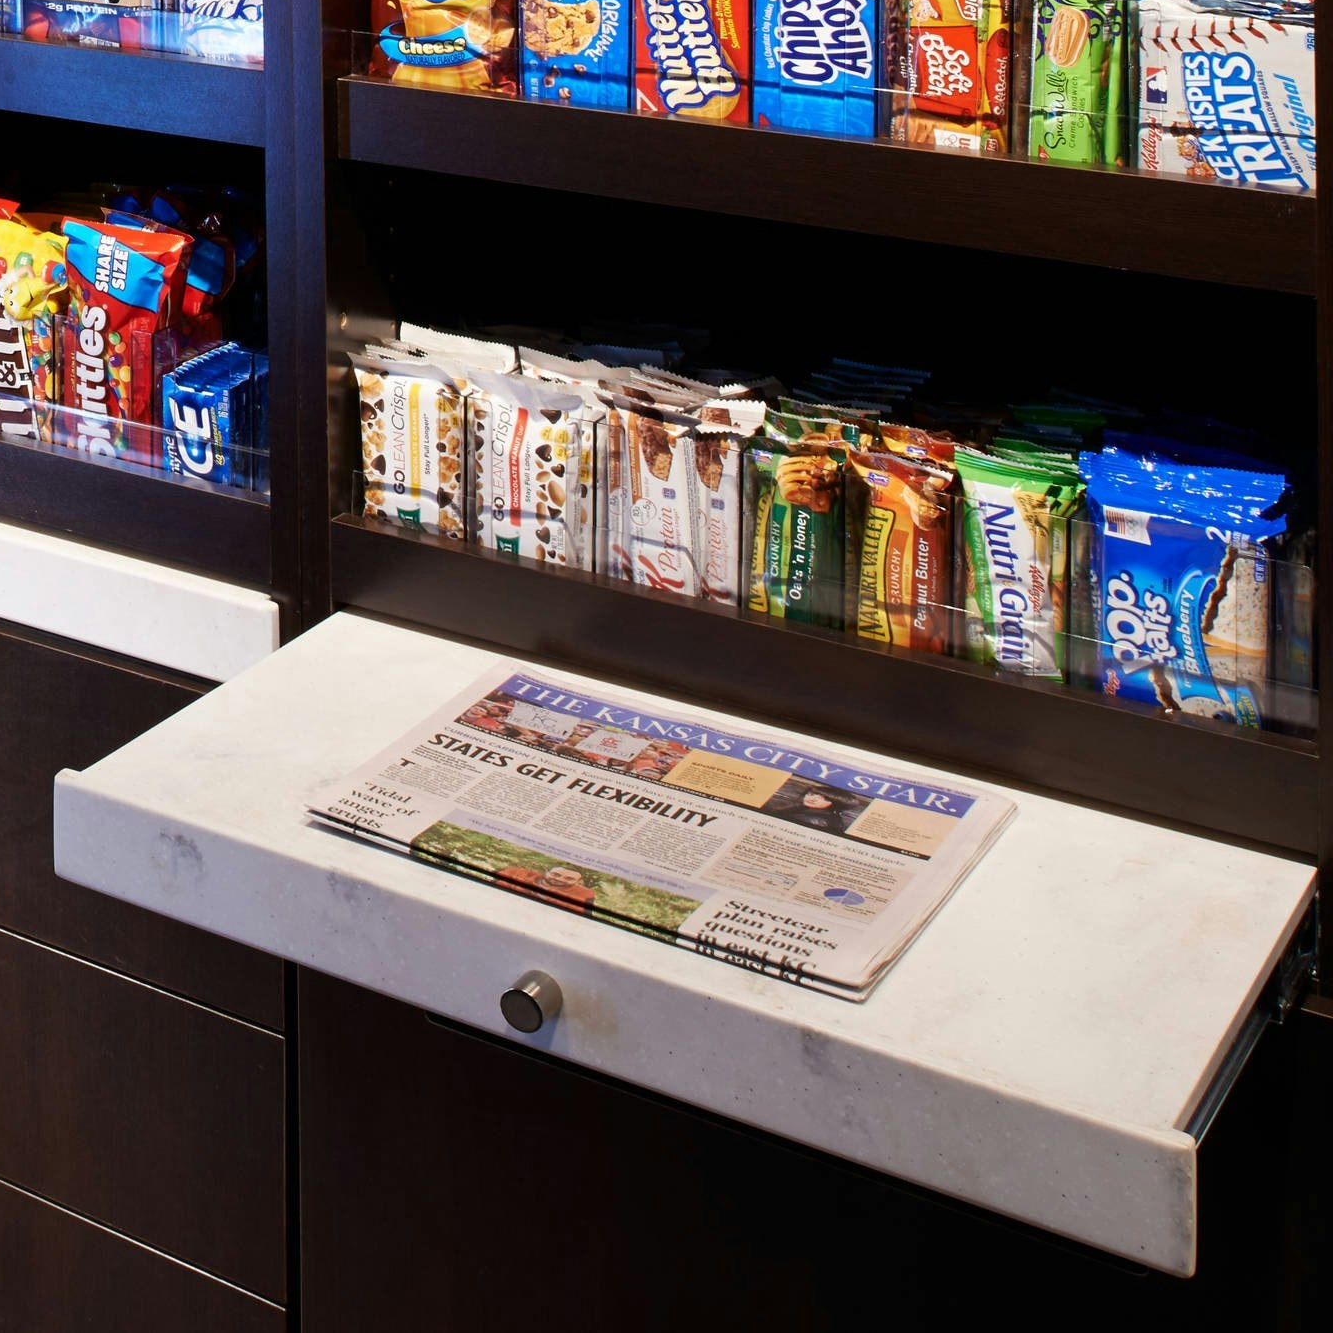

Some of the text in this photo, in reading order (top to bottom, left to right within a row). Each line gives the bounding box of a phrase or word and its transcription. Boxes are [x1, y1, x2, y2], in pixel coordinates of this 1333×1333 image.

[65, 3, 118, 16] PROTEIN
[398, 37, 466, 56] Cheese
[941, 44, 973, 96] Soft
[1141, 114, 1163, 171] Kellogg's
[95, 234, 116, 293] SHARE
[111, 246, 129, 291] SIZE
[511, 435, 521, 469] PEANUT
[512, 469, 521, 508] CHOCOLATE
[770, 520, 781, 577] CRUNCHY
[789, 568, 801, 600] Oats
[796, 510, 810, 552] Honey
[890, 547, 901, 606] CRUNCHY
[914, 537, 932, 630] Peanut Butter
[981, 500, 1034, 662] Nutri Grain
[515, 679, 588, 714] THE
[594, 706, 735, 752] KANSAS
[743, 747, 843, 780] CITY
[351, 789, 420, 817] wave of
[427, 733, 516, 767] STATES
[516, 762, 568, 785] GET
[566, 777, 719, 829] FLEXIBILITY
[328, 806, 383, 829] erupts
[704, 920, 813, 957] questions
[713, 910, 838, 950] plan raises
[725, 900, 830, 934] Streetcar
